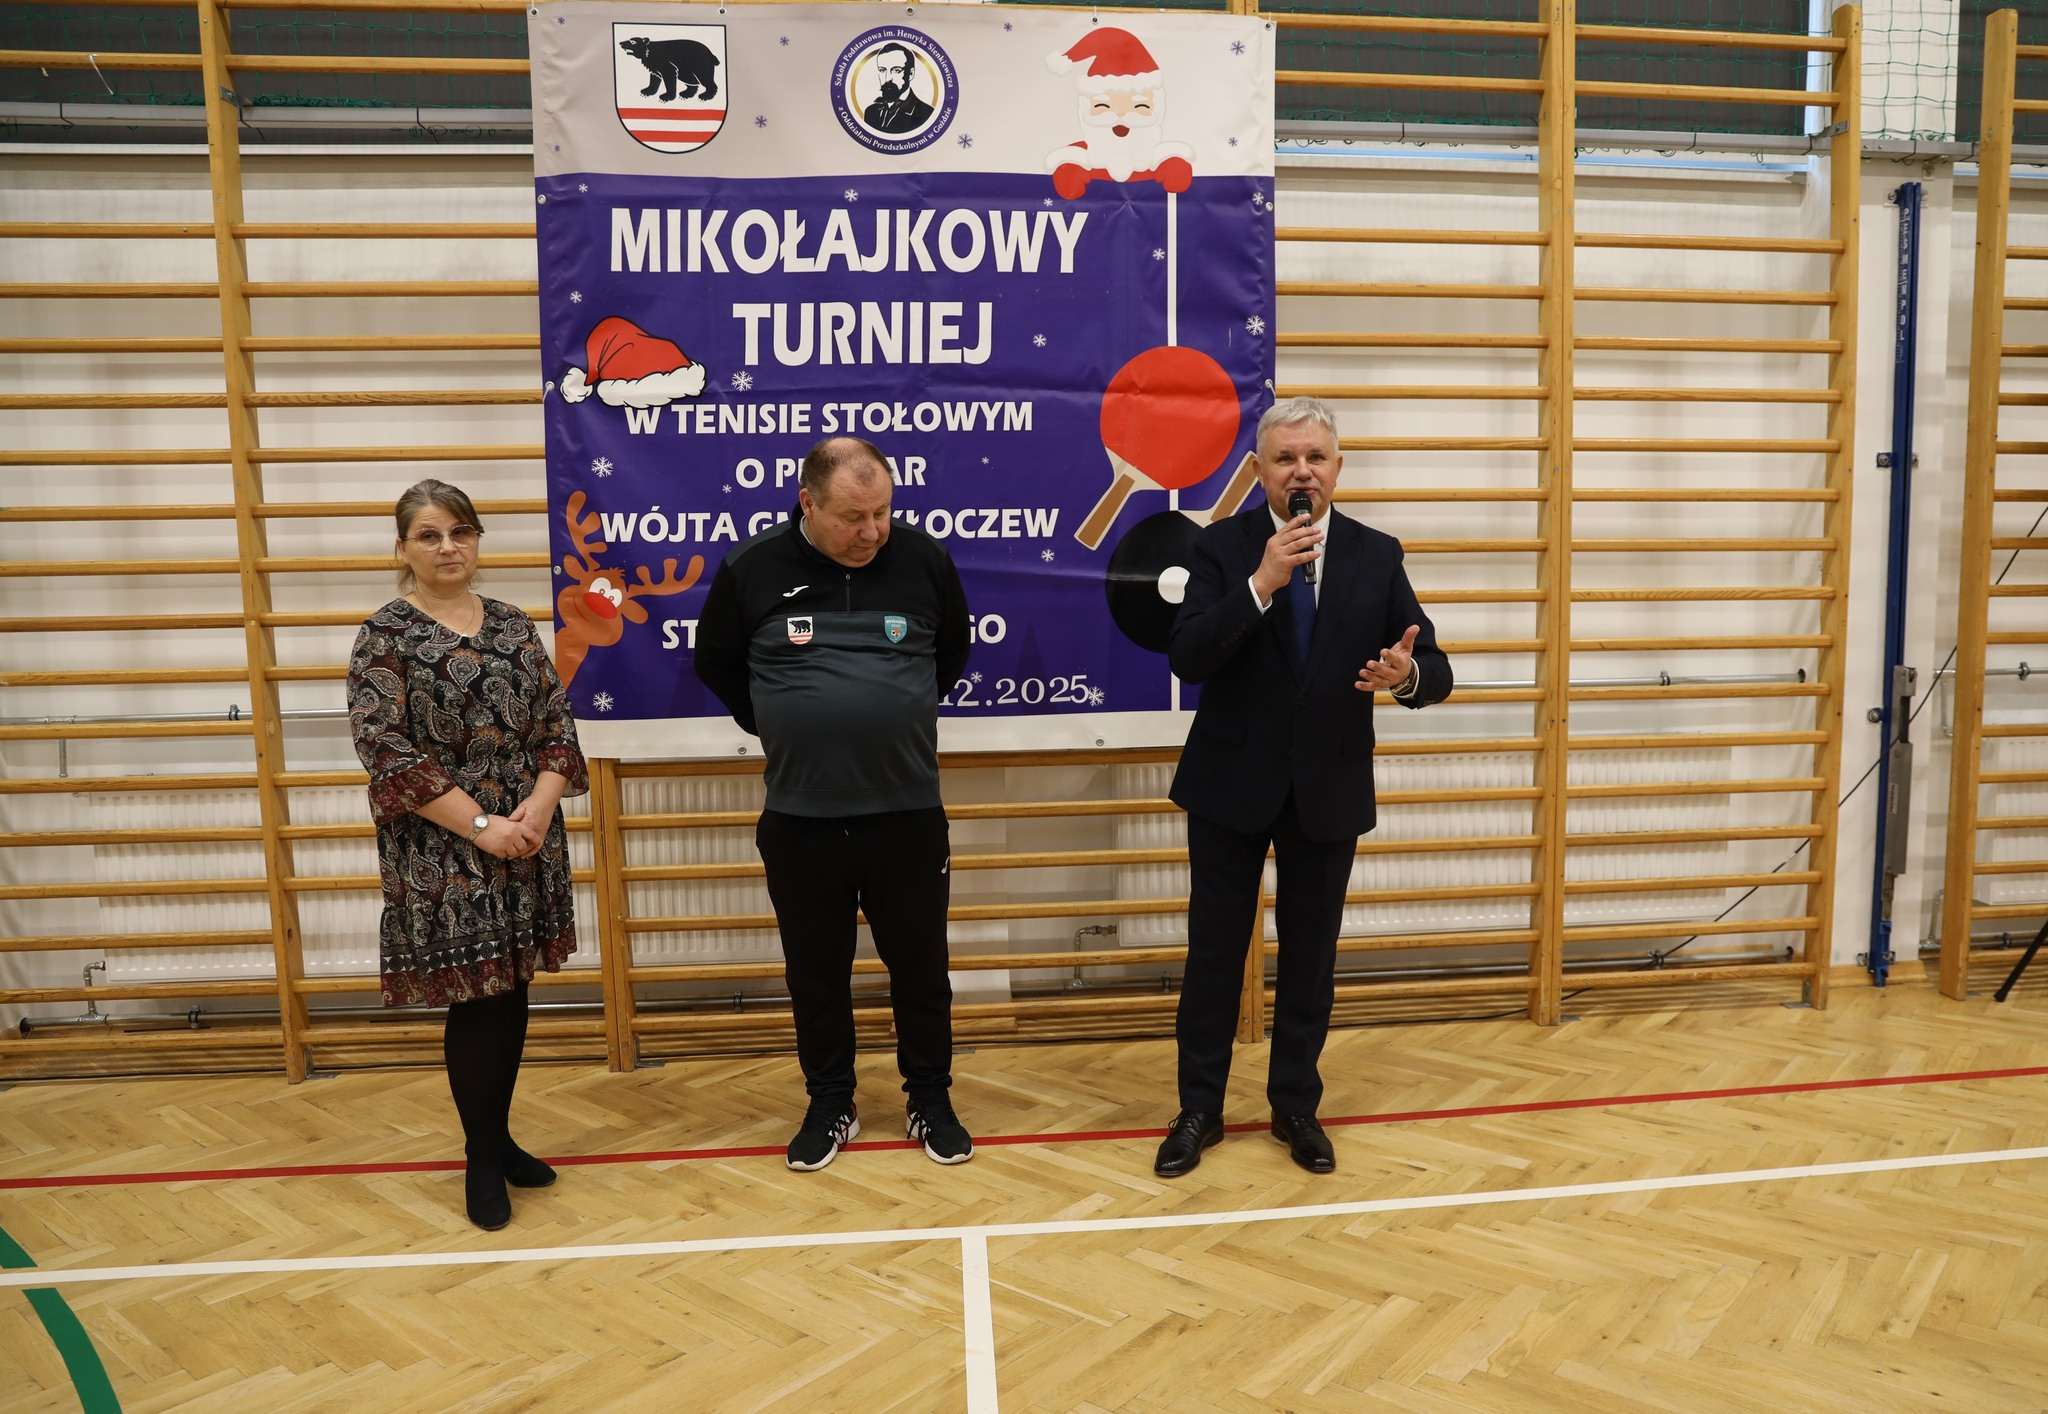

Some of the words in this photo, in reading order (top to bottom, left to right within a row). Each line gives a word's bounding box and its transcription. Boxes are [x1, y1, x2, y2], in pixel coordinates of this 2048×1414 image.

[843, 32, 882, 62] Podstawowa
[883, 29, 896, 37] im.
[897, 30, 927, 46] Henryka
[927, 42, 953, 88] Sienkiewicza
[872, 136, 928, 151] Przedszkolnymi
[611, 208, 1089, 274] MIKOŁAJKOWY
[733, 301, 993, 366] TURNIEJ
[624, 405, 662, 435] W
[671, 404, 812, 435] TENISIE
[821, 401, 1033, 433] STOŁOWYM
[735, 458, 765, 488] O
[600, 506, 739, 543] WÓJTA
